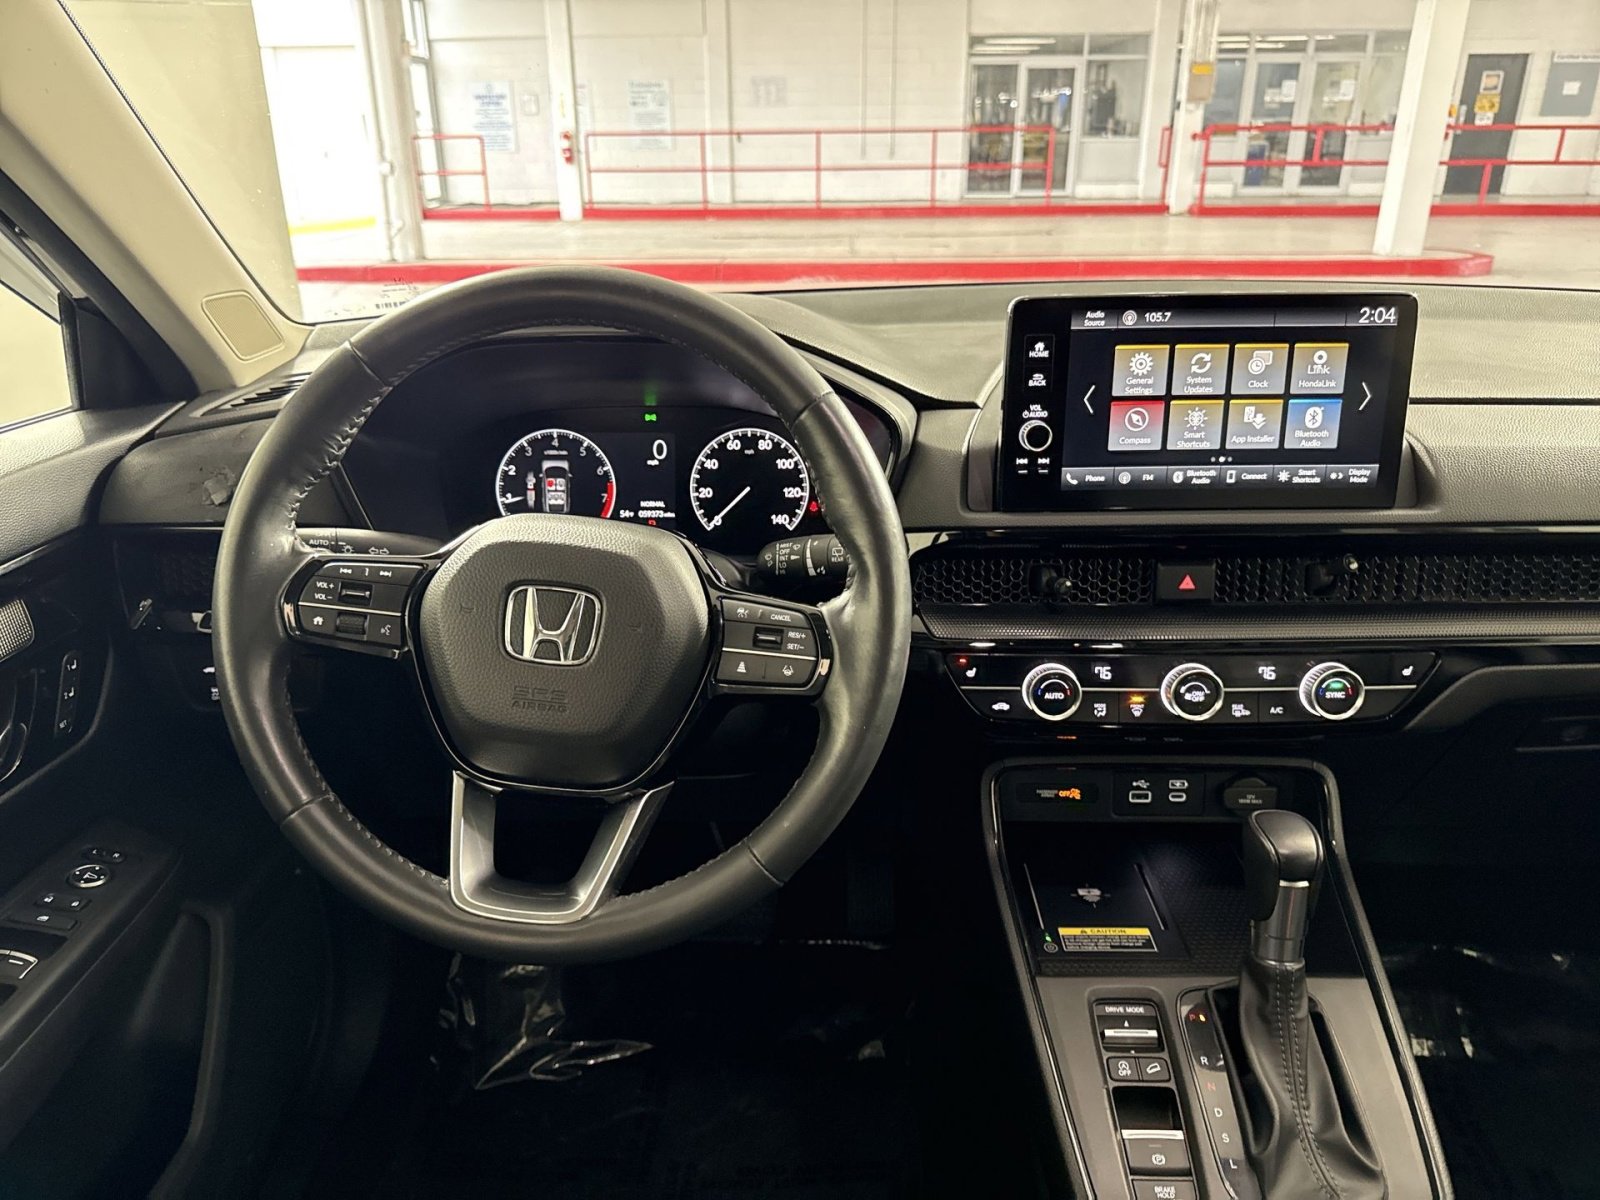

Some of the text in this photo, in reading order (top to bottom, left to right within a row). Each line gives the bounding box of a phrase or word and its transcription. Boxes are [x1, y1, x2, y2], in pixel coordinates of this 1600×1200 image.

[1086, 310, 1105, 318] Audio
[1144, 312, 1172, 322] 105.7
[1358, 307, 1396, 324] 2:04
[1126, 377, 1154, 385] General
[1186, 376, 1212, 385] System
[1248, 379, 1269, 388] Clock
[1298, 379, 1337, 388] HondaLink
[1124, 386, 1154, 396] Settings
[1184, 386, 1214, 394] Updates
[1184, 431, 1206, 439] Smart
[1294, 430, 1330, 438] Bluetooth
[551, 438, 560, 448] 4
[1118, 436, 1152, 446] Compass
[1176, 440, 1210, 448] Shortcuts
[1231, 435, 1276, 444] App Installer
[1300, 439, 1322, 448] Audio
[726, 439, 741, 450] 60
[758, 439, 772, 450] 80
[524, 447, 533, 456] 3
[579, 447, 587, 456] 5
[652, 439, 668, 460] 0
[704, 459, 718, 470] 40
[776, 459, 794, 469] 100
[508, 466, 516, 476] 2
[596, 467, 604, 476] 6
[1348, 468, 1371, 476] Display
[1191, 476, 1211, 484] Audio
[1242, 472, 1268, 480] Connect
[698, 488, 713, 498] 20
[783, 488, 801, 498] 120
[601, 494, 608, 503] 7
[771, 514, 790, 524] 140
[770, 614, 792, 622] CANCEL
[1094, 666, 1112, 680] 76
[1258, 666, 1276, 680] 76
[1044, 692, 1064, 700] AUTO
[1325, 692, 1346, 700] SYNC
[1270, 706, 1284, 714] A/C
[1200, 1056, 1209, 1066] R
[1206, 1082, 1216, 1092] N
[1214, 1108, 1223, 1118] D
[1222, 1132, 1230, 1143] S
[1229, 1158, 1238, 1169] L
